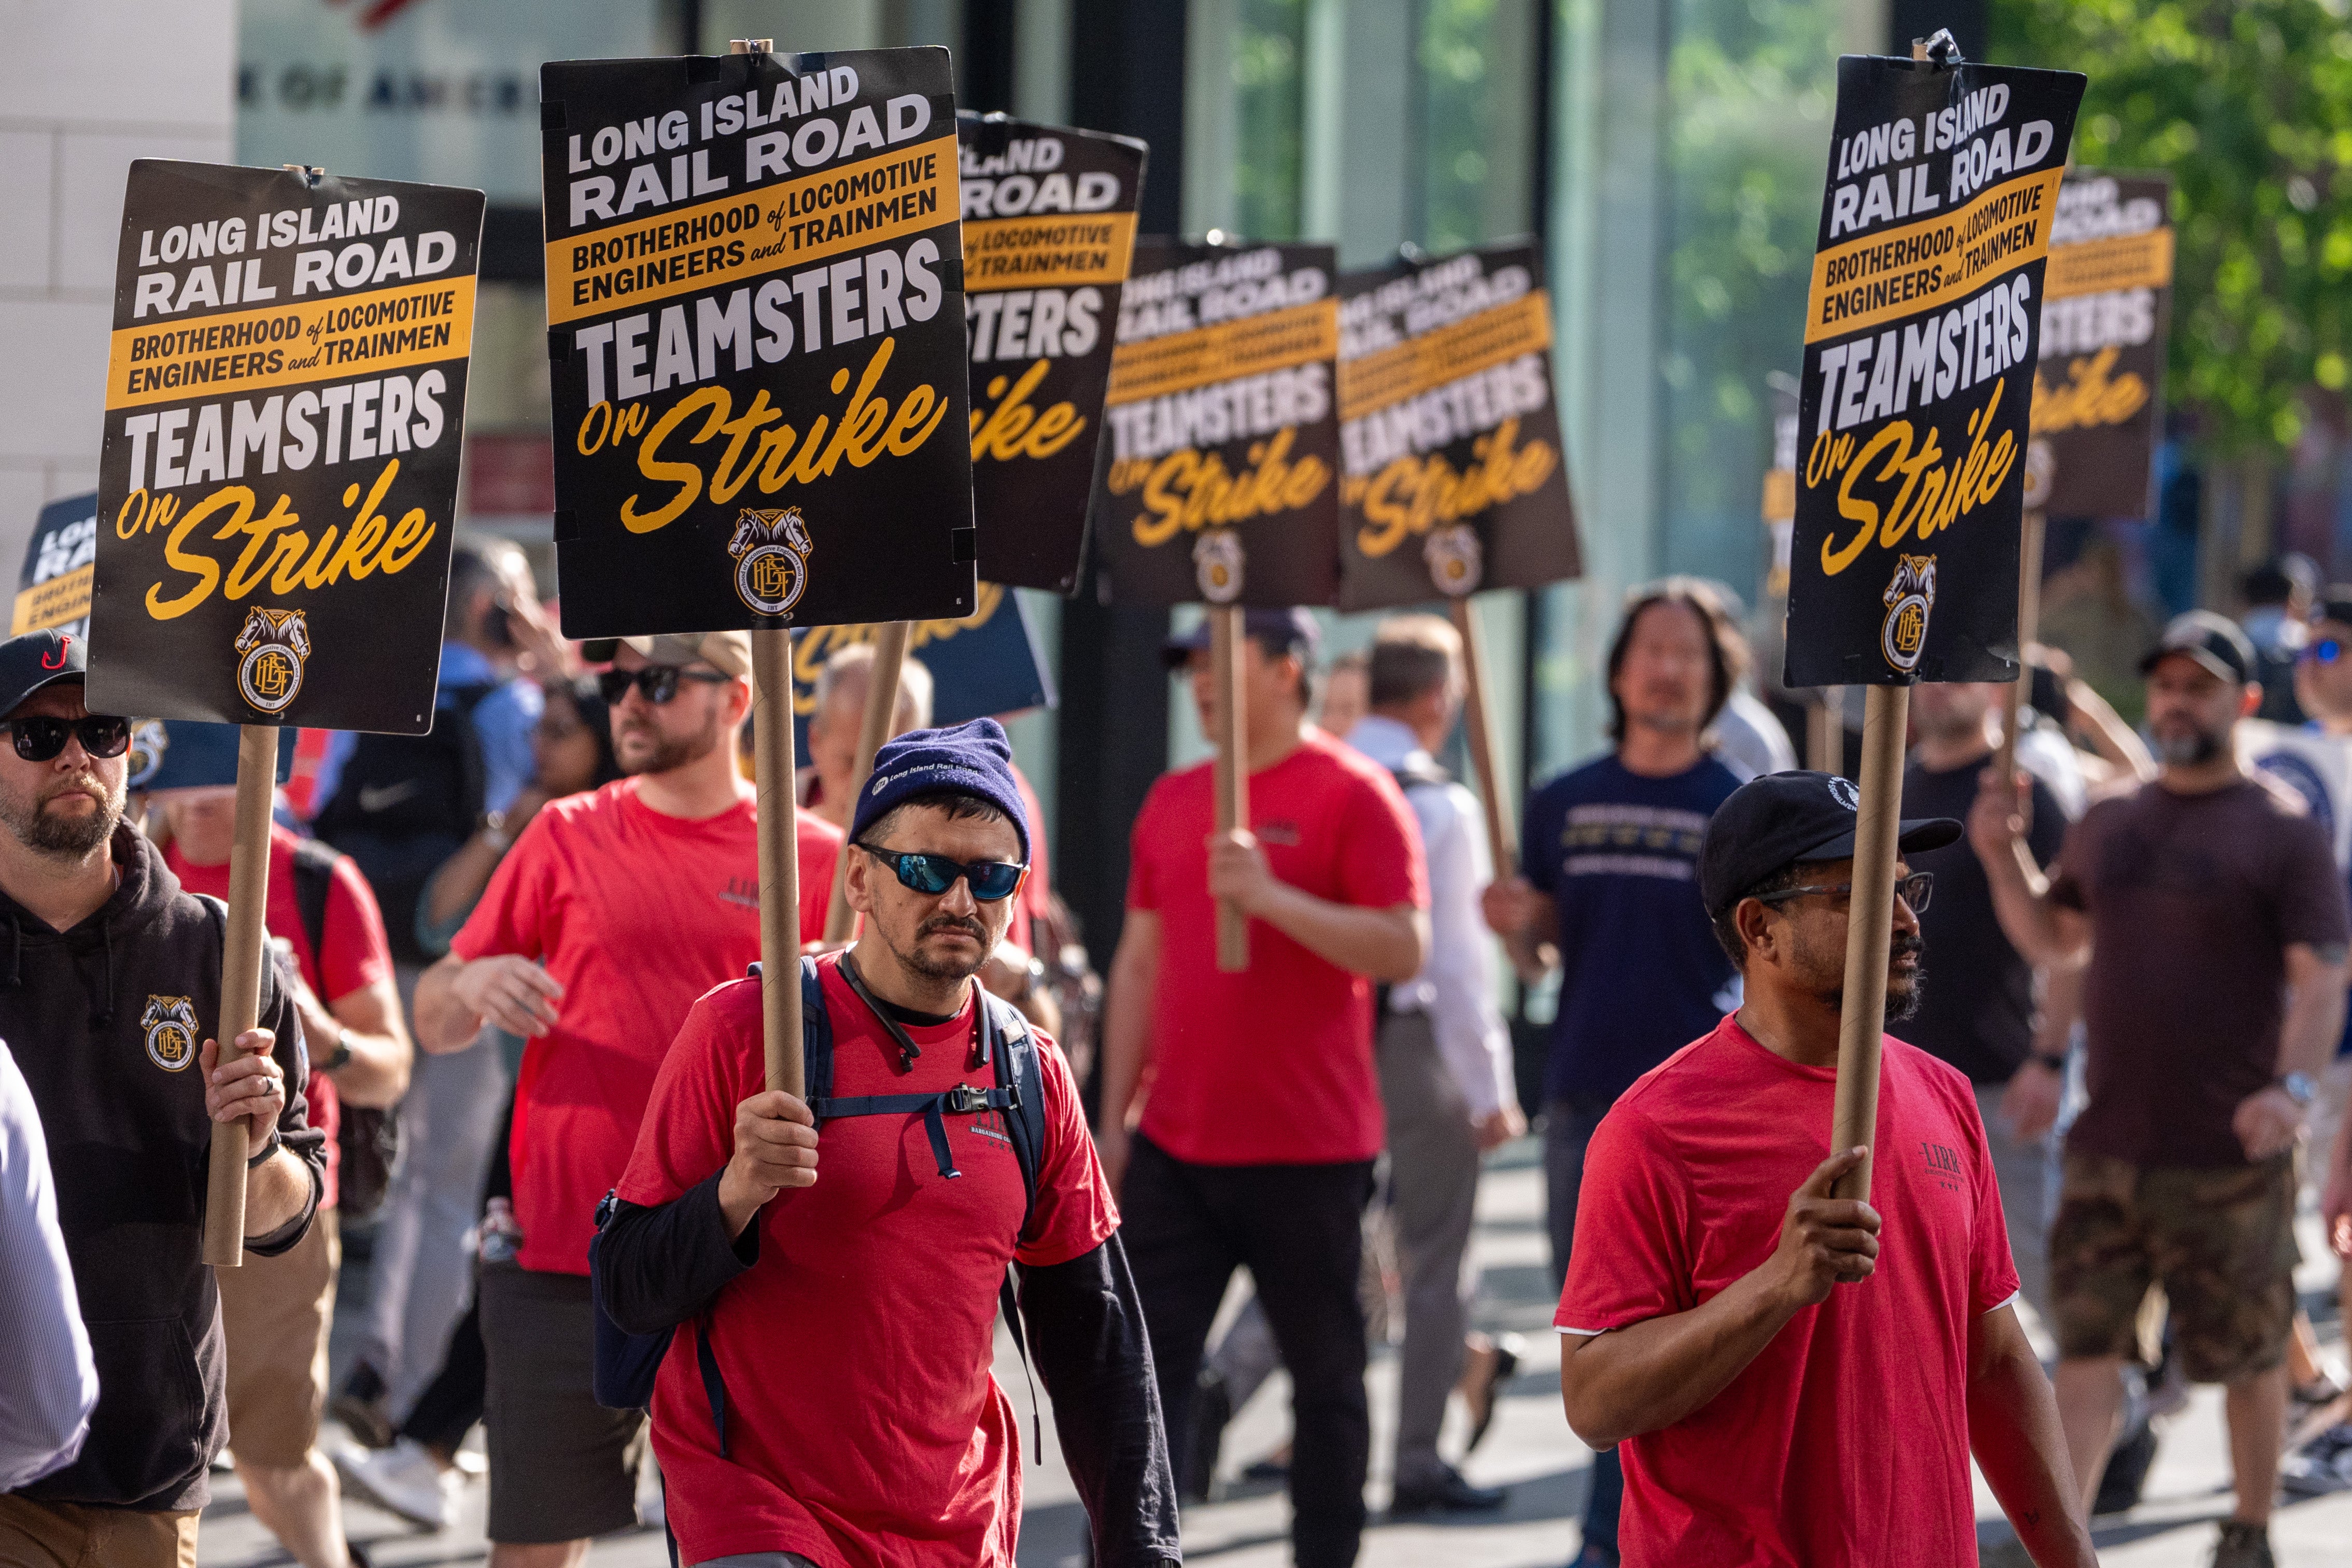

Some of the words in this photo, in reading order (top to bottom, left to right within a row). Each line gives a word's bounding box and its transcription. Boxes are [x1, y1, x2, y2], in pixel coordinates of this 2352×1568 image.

[569, 110, 689, 174] LONG
[701, 65, 859, 139] ISLAND
[569, 150, 728, 227] RAIL
[746, 93, 931, 182] ROAD
[960, 137, 1065, 175] LAND
[1837, 118, 1915, 180] LONG
[1924, 83, 2010, 154] ISLAND
[572, 204, 760, 273] BROTHERHOOD
[766, 200, 785, 232] of
[789, 153, 937, 219] LOCOMOTIVE
[961, 172, 1121, 219] ROAD
[1829, 163, 1940, 238] RAIL
[1949, 119, 2053, 203] ROAD
[133, 258, 276, 318] RAIL
[292, 231, 456, 296] ROAD
[139, 217, 246, 267] LONG
[256, 195, 399, 250] ISLAND
[572, 241, 745, 306] ENGINEERS
[750, 232, 786, 261] and
[789, 187, 937, 250] TRAINMEN
[982, 251, 1108, 276] TRAINMEN
[983, 224, 1112, 250] LOCOMOTIVE
[1822, 265, 1941, 324] ENGINEERS
[1943, 267, 1964, 288] and
[1965, 219, 2037, 279] TRAINMEN
[1825, 225, 1954, 287] BROTHERHOOD
[1956, 224, 1966, 252] of
[1967, 185, 2044, 242] LOCOMOTIVE
[128, 349, 284, 394] ENGINEERS
[288, 347, 321, 372] and
[324, 322, 452, 365] TRAINMEN
[130, 315, 301, 361] BROTHERHOOD
[307, 317, 323, 345] of
[326, 291, 455, 333] LOCOMOTIVE
[575, 237, 942, 408] TEAMSTERS
[1818, 273, 2030, 436] TEAMSTERS
[125, 369, 446, 493] TEAMSTERS
[576, 400, 650, 456] On
[621, 336, 948, 534] Strike
[970, 358, 1087, 462] ike
[1108, 362, 1331, 458] TEAMSTERS
[1339, 352, 1547, 475] EAMSTERS
[1132, 426, 1332, 546] Strike
[1357, 416, 1556, 558] Strike
[1806, 429, 1855, 489] On
[1821, 377, 2018, 576] Strike
[116, 488, 180, 540] On
[145, 458, 435, 620] Strike
[745, 546, 776, 564] Locomotive
[777, 546, 798, 566] Engineers
[741, 571, 758, 605] Brotherhood
[786, 576, 802, 602] Trainmen
[250, 645, 279, 660] Locomotive
[280, 646, 298, 666] Engineers
[890, 770, 908, 781] Long
[910, 764, 934, 773] Island
[971, 1126, 1003, 1140] BARGAINING
[1922, 1142, 1961, 1174] LIRR
